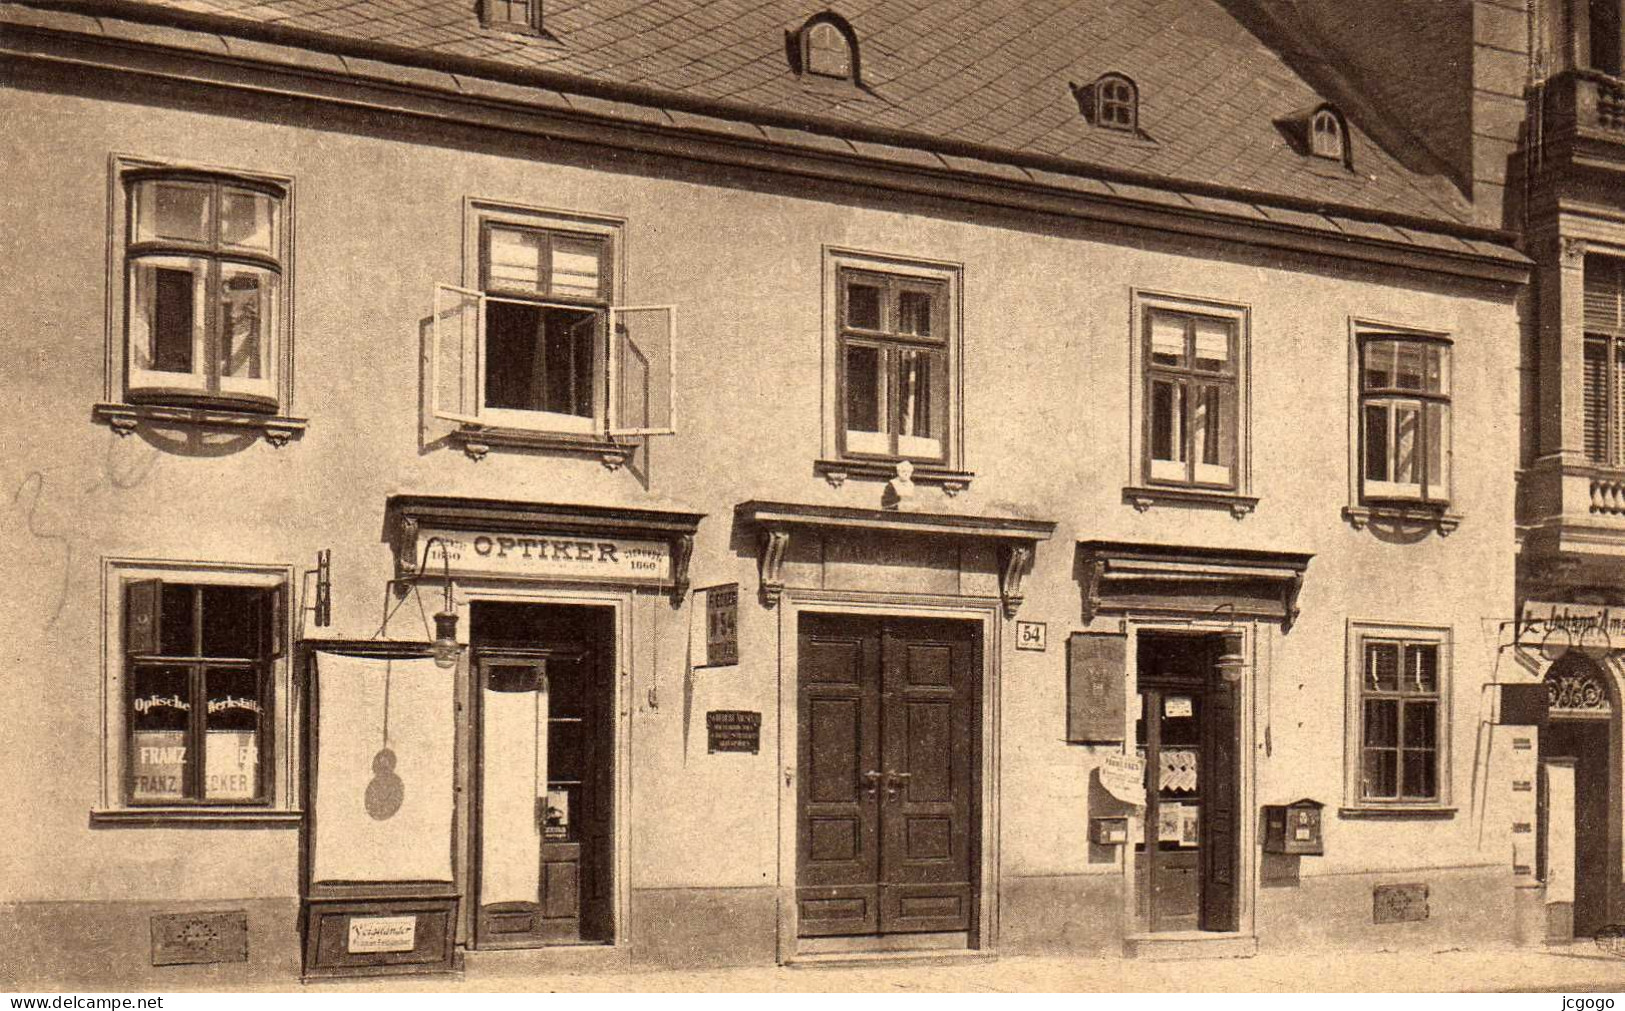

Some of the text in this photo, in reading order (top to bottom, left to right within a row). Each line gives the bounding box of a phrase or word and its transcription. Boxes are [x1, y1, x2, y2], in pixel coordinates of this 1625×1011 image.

[474, 535, 619, 563] OPTIKER
[1023, 625, 1040, 642] 54
[140, 746, 187, 764] FRANZ
